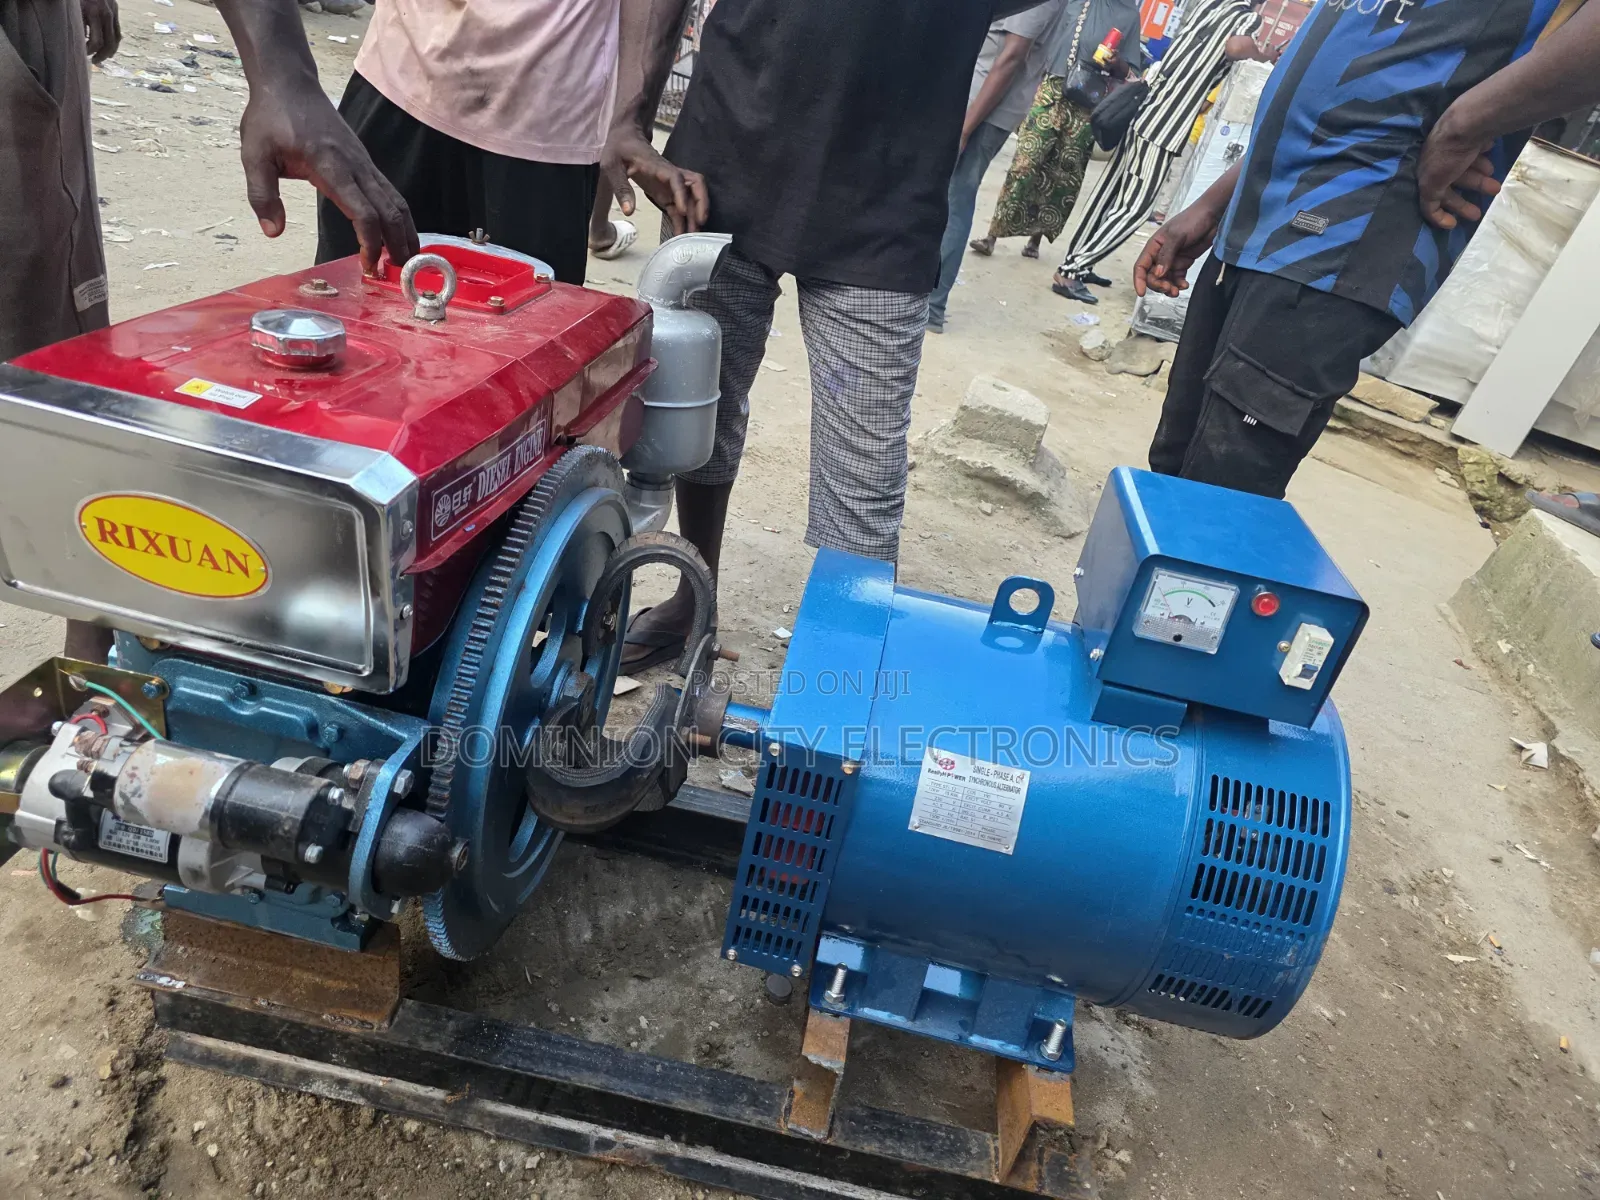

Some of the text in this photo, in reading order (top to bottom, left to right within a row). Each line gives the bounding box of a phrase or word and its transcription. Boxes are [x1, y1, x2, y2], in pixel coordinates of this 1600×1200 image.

[1327, 0, 1414, 23] port
[476, 427, 544, 502] DIESEL ENGINE
[93, 516, 250, 579] RIXUAN
[972, 765, 990, 776] SINGLE
[968, 775, 1021, 794] SYNCHRONOUS ALTERNATOR
